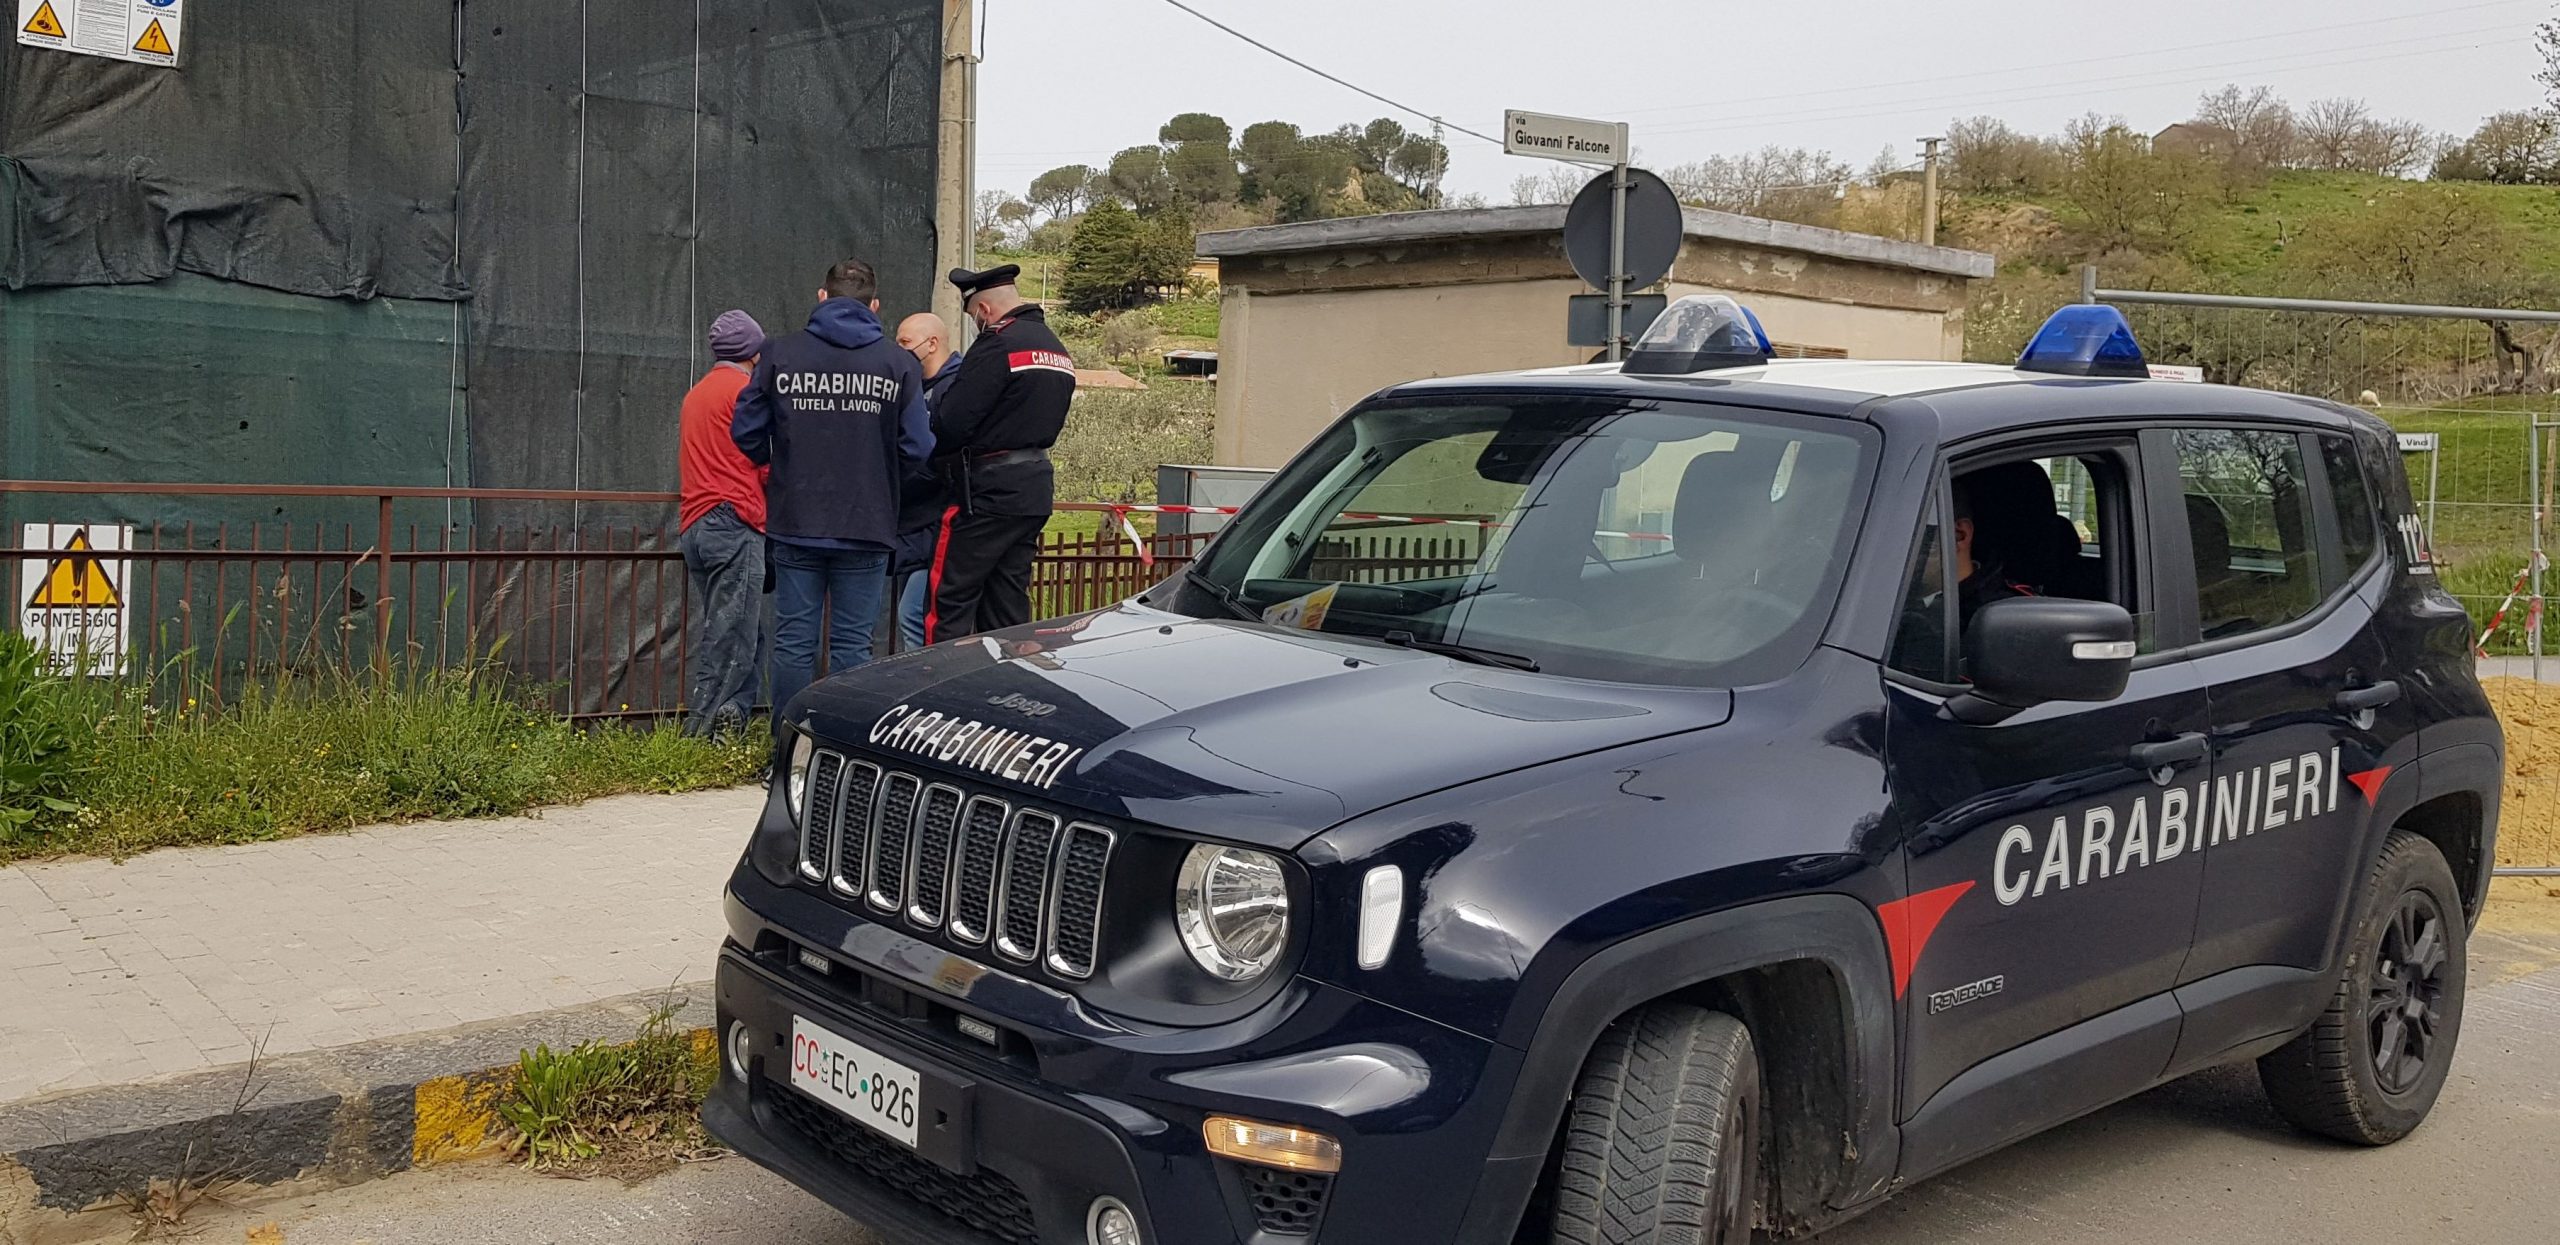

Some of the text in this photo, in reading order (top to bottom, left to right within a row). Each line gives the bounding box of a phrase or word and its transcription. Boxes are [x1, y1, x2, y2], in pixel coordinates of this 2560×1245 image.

[1515, 116, 1526, 126] via
[1515, 130, 1610, 154] Giovanni Falcone
[776, 372, 900, 403] CARABINIERI
[792, 398, 835, 411] TUTELA
[2396, 513, 2431, 564] 112
[67, 632, 81, 648] IN
[987, 692, 1057, 718] Jeep
[868, 704, 1084, 790] CARABINIERI
[1992, 745, 2341, 907] CARABINIERI
[1929, 974, 2004, 1015] RENEGADE
[870, 1072, 915, 1129] 826
